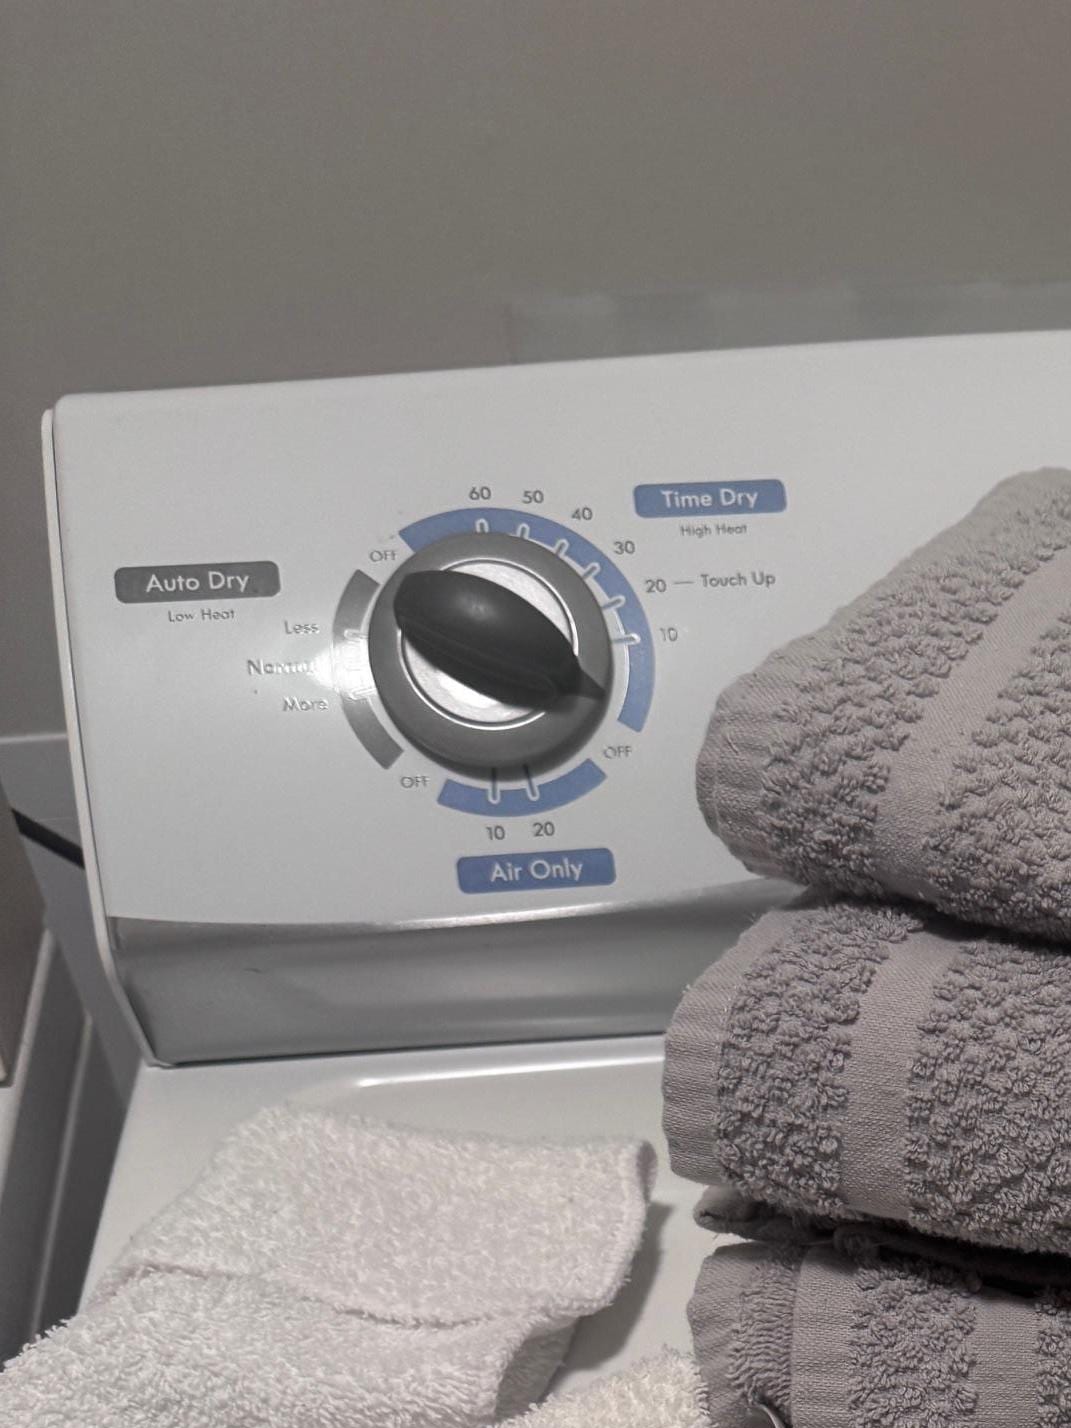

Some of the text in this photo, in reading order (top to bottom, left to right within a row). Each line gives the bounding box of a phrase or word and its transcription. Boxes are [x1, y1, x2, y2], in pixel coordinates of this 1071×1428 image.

[469, 486, 491, 500] 60
[522, 490, 544, 504] 50
[660, 488, 758, 508] Time Dry
[571, 507, 593, 521] 40
[680, 523, 747, 539] High Heat
[613, 540, 636, 555] 30
[146, 571, 250, 593] Auto Dry
[645, 573, 776, 593] 20 Touch Up
[168, 608, 235, 622] Low Heat
[284, 620, 320, 635] Less
[660, 627, 679, 642] 10
[283, 697, 329, 712] More
[603, 745, 632, 759] OFF
[400, 775, 429, 789] OFF
[486, 825, 506, 841] 10
[533, 822, 556, 837] 20
[490, 857, 584, 883] Air Only
